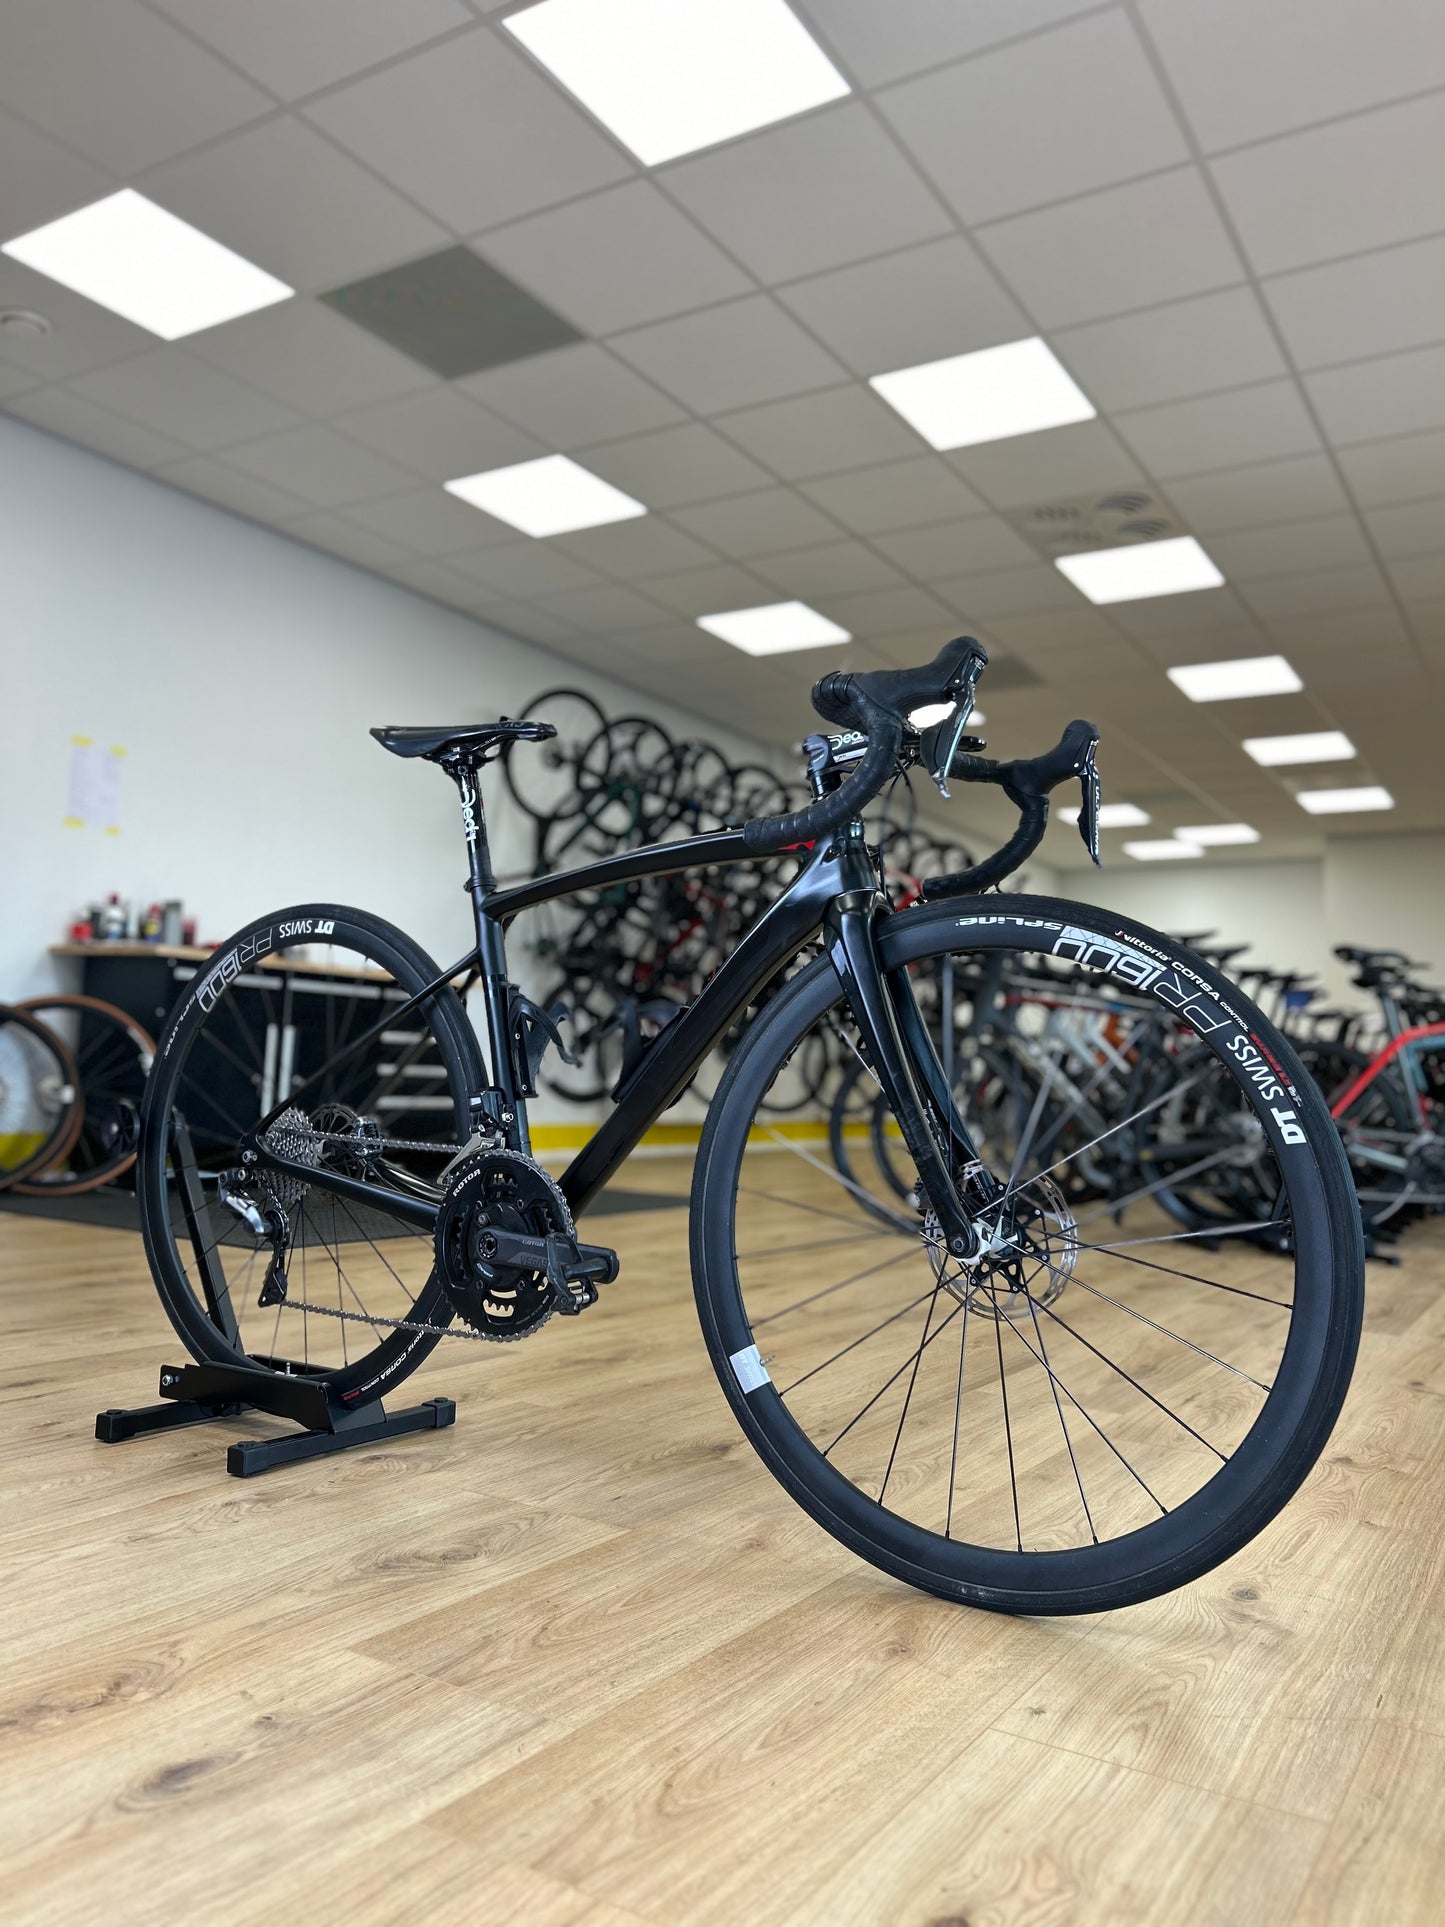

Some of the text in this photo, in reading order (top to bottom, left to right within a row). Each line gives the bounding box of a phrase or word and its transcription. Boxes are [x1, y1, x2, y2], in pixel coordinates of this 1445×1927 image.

[279, 920, 335, 938] DT SWISS
[1123, 933, 1249, 1032] vittoria CORSA CONTROL
[1226, 1034, 1285, 1101] SWISS
[1270, 1107, 1307, 1145] DT
[453, 1168, 481, 1197] ROTOR
[380, 1352, 407, 1380] CORSA
